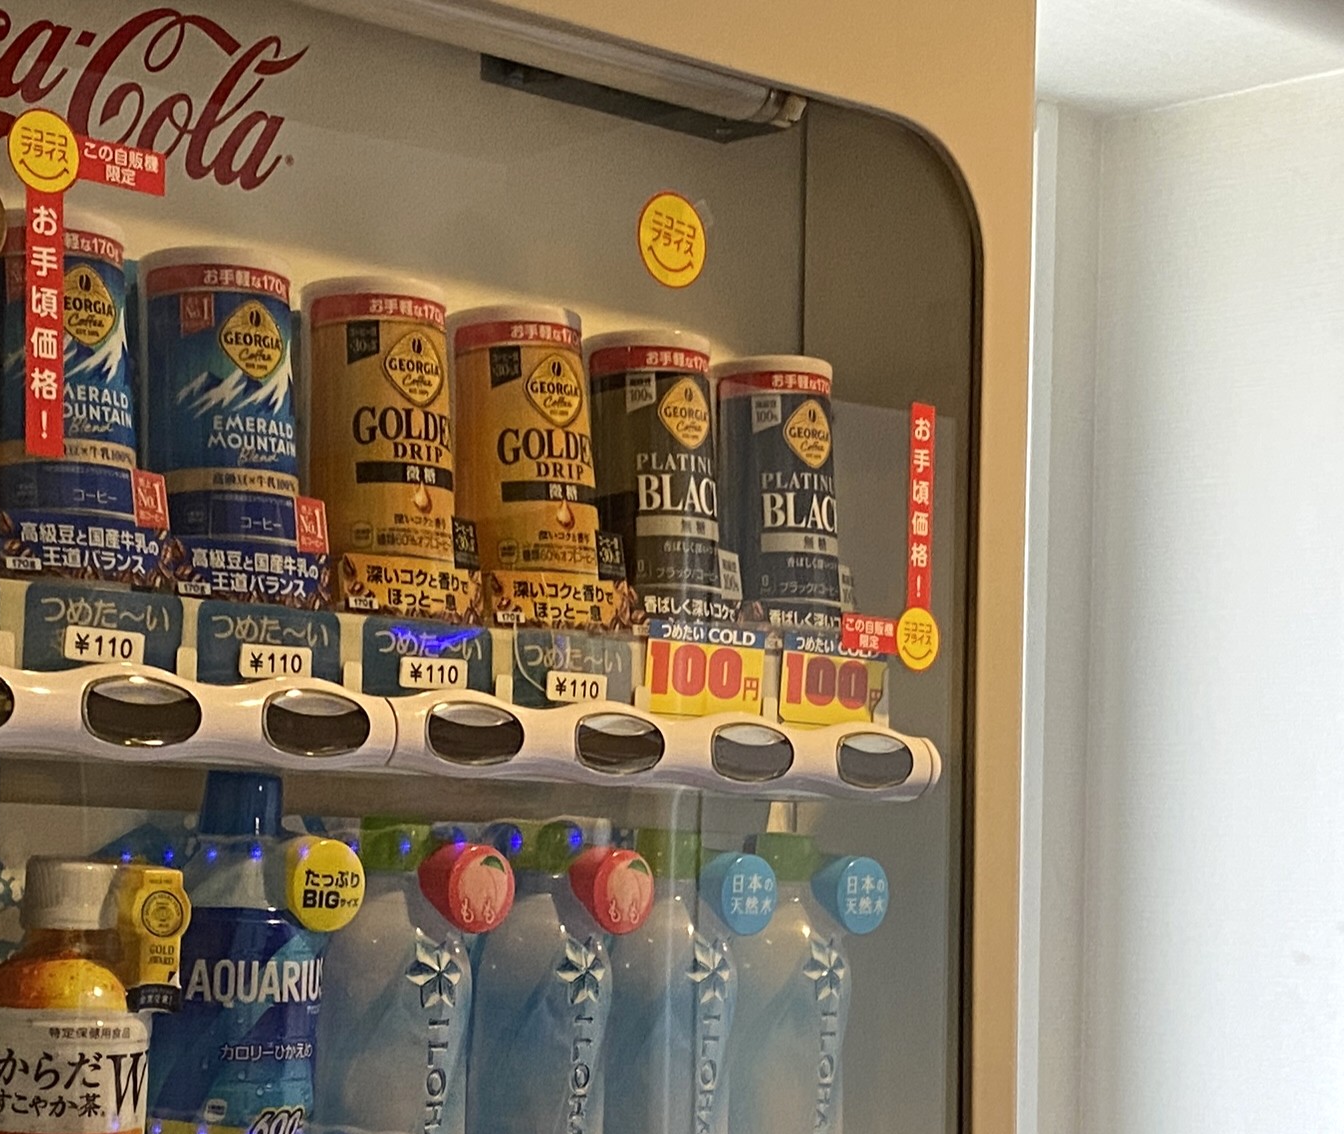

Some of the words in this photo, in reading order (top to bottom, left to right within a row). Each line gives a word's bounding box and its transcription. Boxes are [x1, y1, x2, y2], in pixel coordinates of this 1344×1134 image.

[20, 125, 68, 146] ニコニコ
[20, 141, 68, 165] プライス
[83, 142, 159, 174] この自販機
[106, 166, 137, 187] 限定
[212, 414, 294, 438] EMERALD
[352, 405, 451, 449] GOLDE
[207, 433, 297, 458] MOUNTAIN
[393, 443, 444, 461] DRIP
[536, 460, 584, 480] DRIP
[74, 488, 118, 503] コーヒー
[637, 473, 718, 517] BLAC
[19, 521, 159, 556] 高級豆と国産牛乳の
[43, 545, 146, 575] 王道バランス
[192, 547, 319, 580] 高級豆と国産牛乳の
[212, 571, 307, 598] 王道バランス
[366, 564, 469, 595] 深いコクと香りで
[387, 587, 456, 611] ほっと一息
[74, 632, 133, 659] ¥110
[661, 625, 705, 641] つめたい
[708, 628, 755, 647] COLD
[250, 652, 302, 674] ¥110
[650, 640, 760, 702] 100円
[731, 873, 774, 894] 日本の
[302, 889, 341, 909] BIG
[460, 897, 497, 924] もも
[730, 895, 774, 915] 天然水
[49, 1026, 131, 1041] 特定保健用食品
[220, 1042, 313, 1061] カロリーひかえめ
